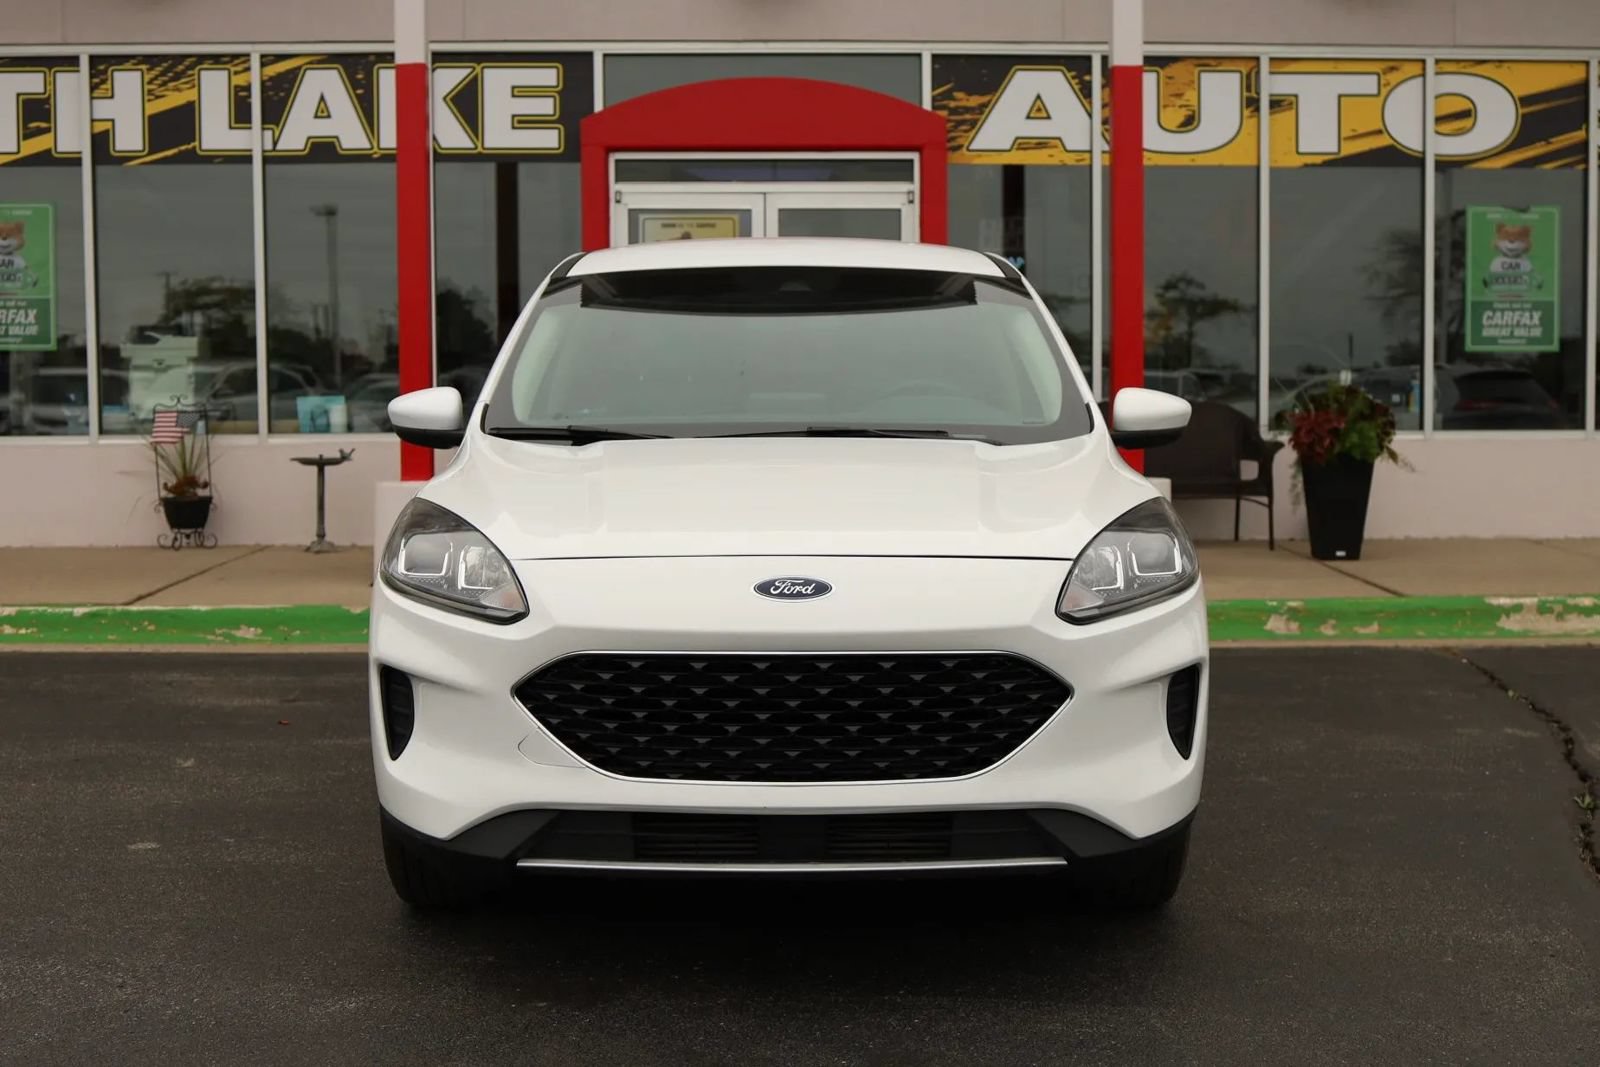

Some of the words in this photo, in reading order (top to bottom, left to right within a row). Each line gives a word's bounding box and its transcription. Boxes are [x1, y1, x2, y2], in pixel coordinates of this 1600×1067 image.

[195, 64, 565, 154] LAKE
[964, 65, 1521, 161] AUTO
[1482, 310, 1542, 326] CARFAX
[770, 579, 816, 595] Ford
